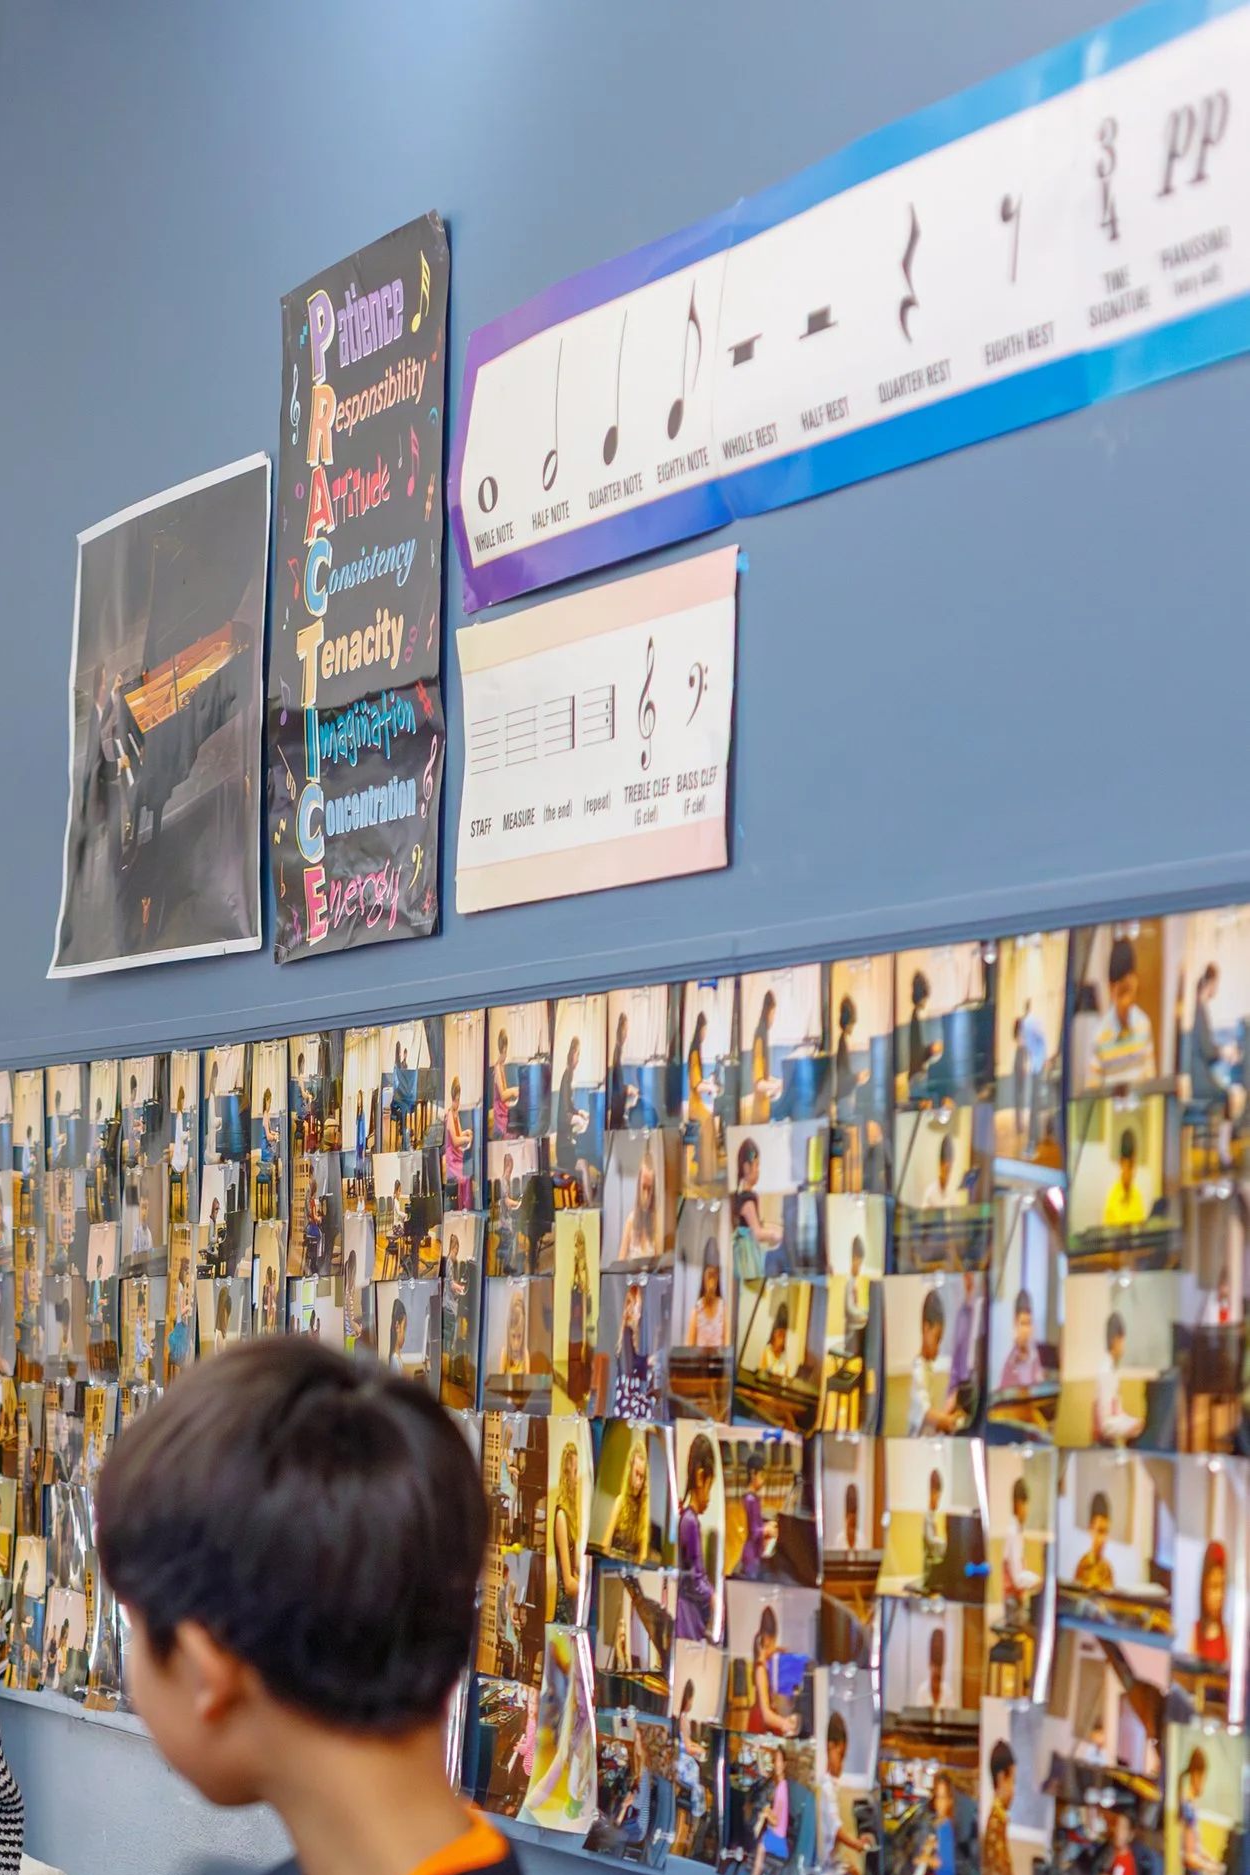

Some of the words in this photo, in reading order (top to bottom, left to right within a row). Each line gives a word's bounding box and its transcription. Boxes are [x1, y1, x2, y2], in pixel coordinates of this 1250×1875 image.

[307, 278, 404, 385] Patience
[985, 333, 1025, 365] EIGHTH
[1027, 321, 1055, 350] REST
[878, 369, 925, 404] QUARTER
[927, 358, 952, 387] REST
[306, 357, 428, 467] Responsibility
[801, 405, 825, 431] HALF
[826, 396, 850, 423] REST
[722, 432, 754, 460] WHOLE
[756, 423, 779, 450] REST
[657, 455, 686, 484] EIGHTH
[687, 447, 710, 475] NOTE
[588, 481, 622, 510] QUARTER
[623, 472, 644, 497] NOTE
[532, 509, 549, 531] HALF
[551, 500, 570, 524] NOTE
[474, 527, 496, 552] WHOLE
[496, 521, 514, 547] NOTE
[304, 537, 417, 617] Consistency
[297, 607, 404, 709] Tenacity
[305, 689, 416, 783] Imagination
[624, 780, 651, 805] TREBLE
[652, 776, 671, 798] CLEF
[676, 769, 699, 794] BASS
[700, 765, 718, 788] CLEF
[297, 775, 416, 864] Concentration
[502, 807, 535, 831] MEASURE
[583, 790, 612, 815] (repeat)
[470, 817, 492, 838] STAFF
[304, 857, 402, 946] Energy
